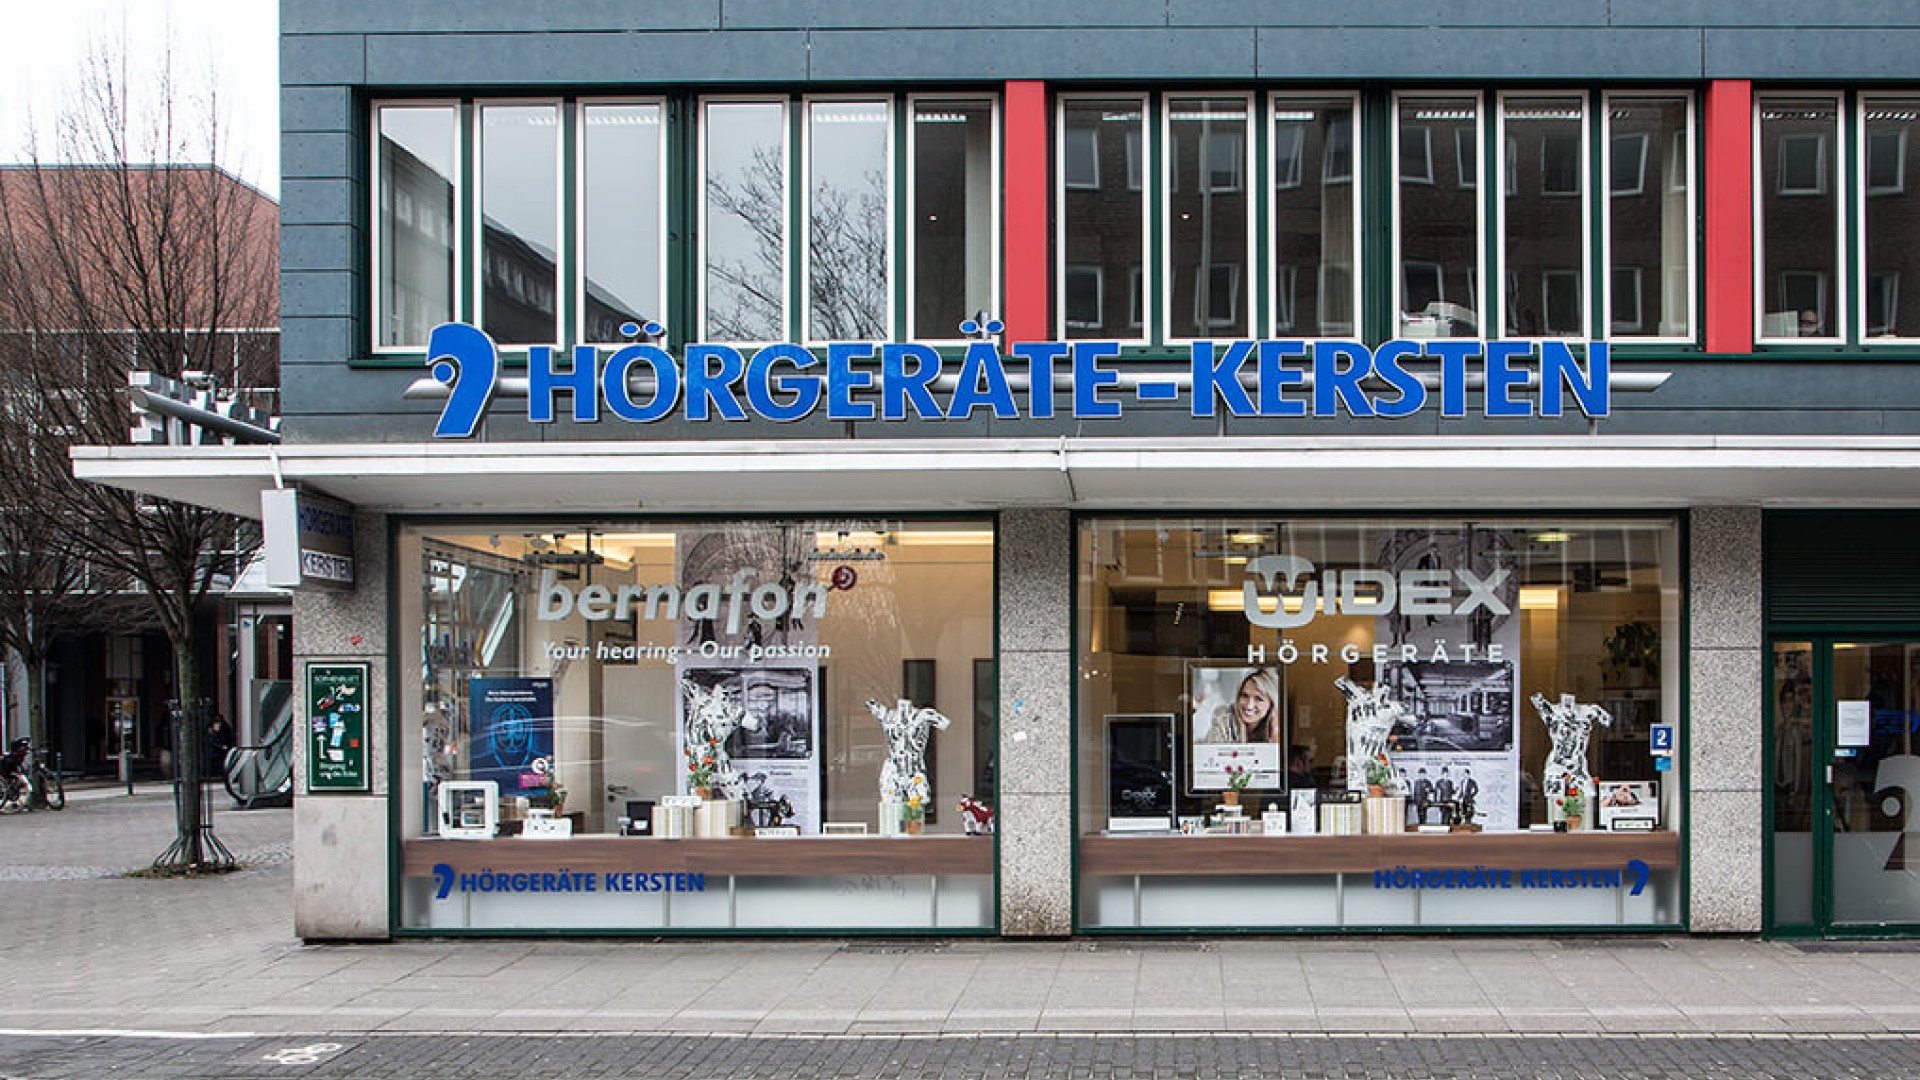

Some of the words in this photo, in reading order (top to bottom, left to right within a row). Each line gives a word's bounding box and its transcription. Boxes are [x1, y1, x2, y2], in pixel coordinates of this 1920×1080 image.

[537, 566, 829, 635] bernafon
[1243, 555, 1511, 629] WIDEX
[542, 642, 590, 660] Your
[596, 640, 679, 664] hearing
[700, 641, 745, 660] Our
[750, 642, 831, 661] passion
[1247, 639, 1504, 664] HÖRGERÄTE
[460, 869, 597, 894] HÖRGERÄTE
[605, 872, 705, 894] KERSTEN
[1374, 865, 1513, 890] HÖRGERÄTE
[1521, 869, 1622, 891] KERSTEN
